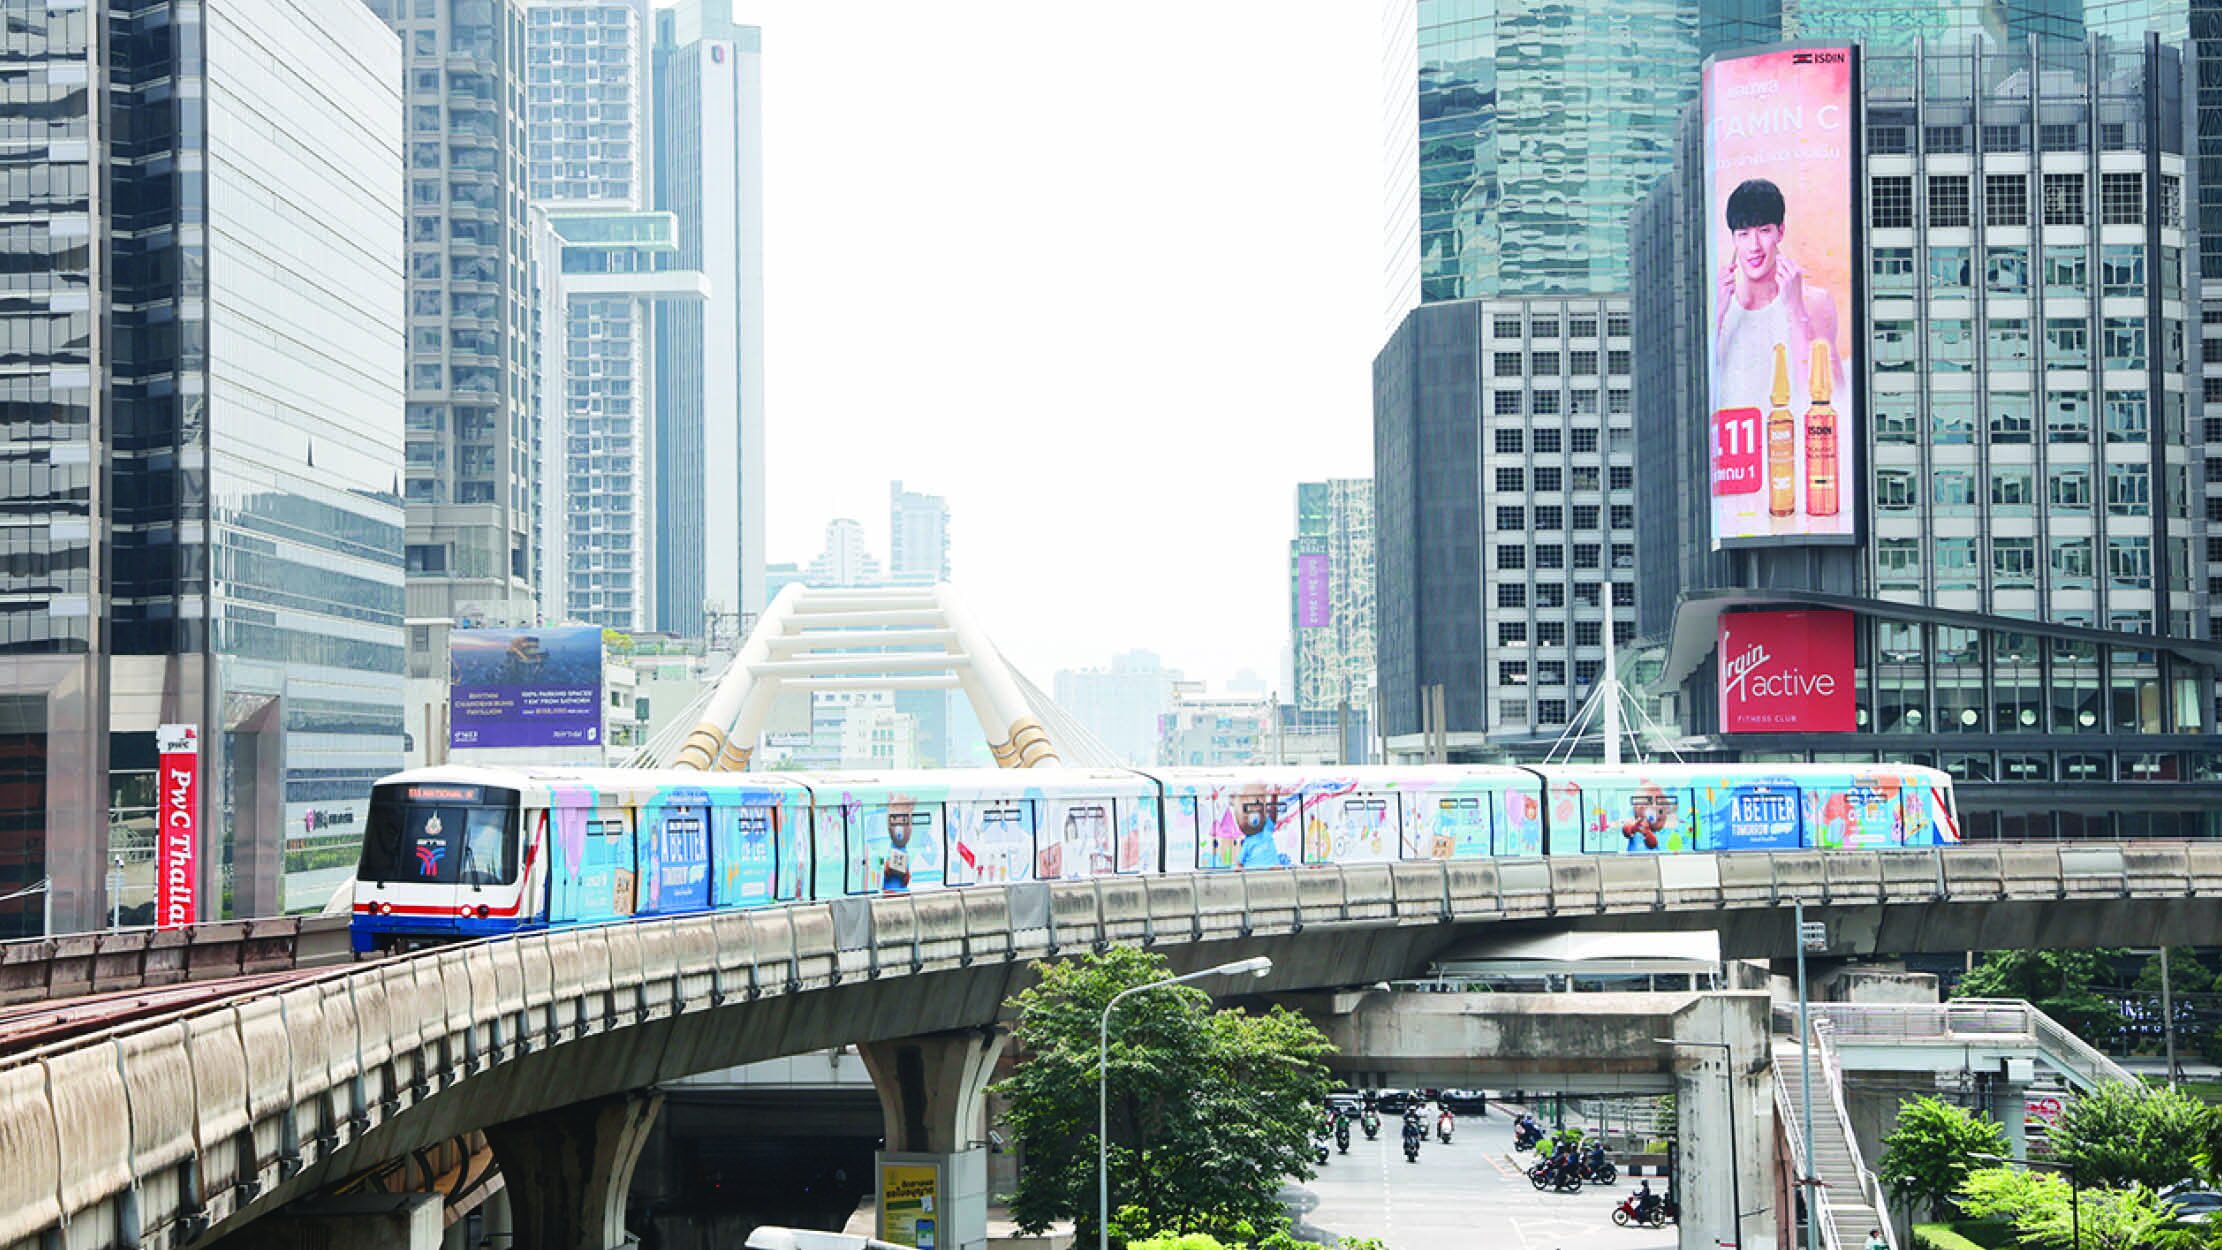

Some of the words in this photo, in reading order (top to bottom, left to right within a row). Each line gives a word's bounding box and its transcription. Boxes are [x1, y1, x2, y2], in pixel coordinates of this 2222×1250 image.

[1814, 53, 1844, 63] ISDIN
[1815, 105, 1840, 129] C
[1751, 668, 1835, 696] active
[1737, 715, 1772, 723] FITNESS
[1774, 715, 1797, 723] CLUB
[1731, 797, 1742, 822] A
[1743, 796, 1796, 821] BETTER
[169, 834, 193, 931] Thaila
